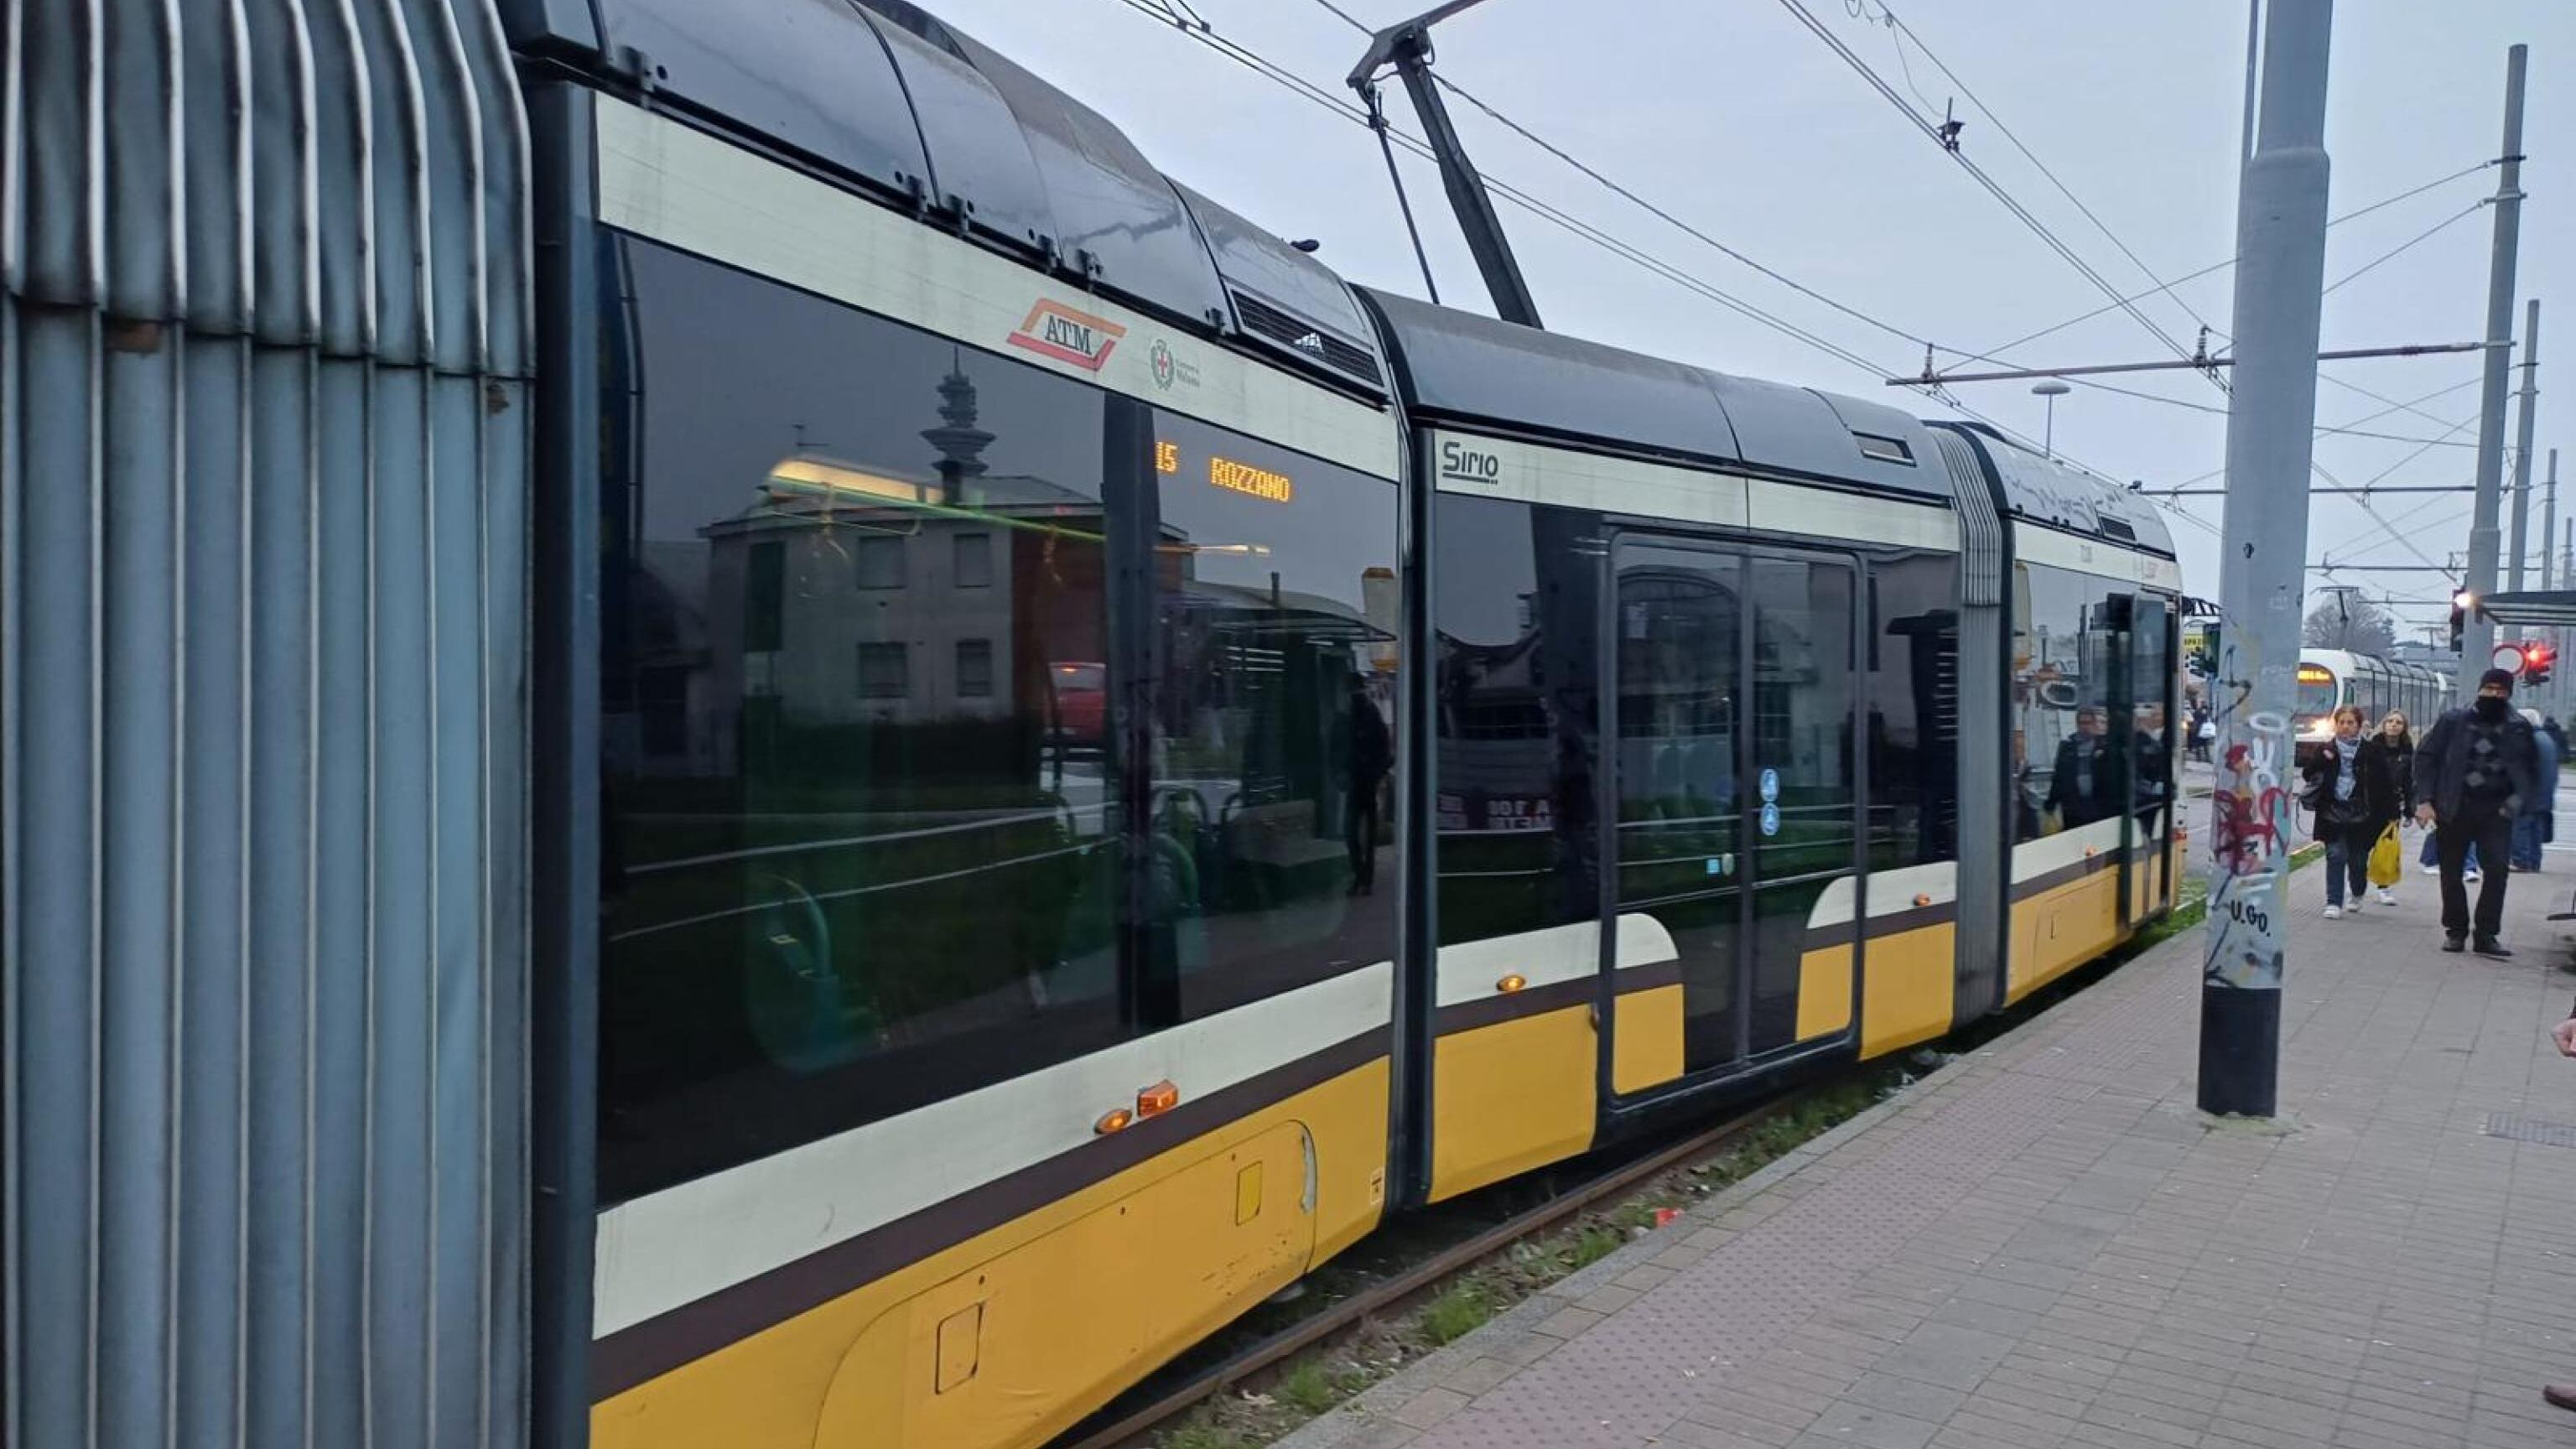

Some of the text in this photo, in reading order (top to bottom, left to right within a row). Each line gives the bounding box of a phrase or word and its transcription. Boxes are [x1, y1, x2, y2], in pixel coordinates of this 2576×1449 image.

[1045, 314, 1093, 356] ATM
[1156, 441, 1290, 503] 15 ROZZANO
[1442, 441, 1499, 477] Sirio
